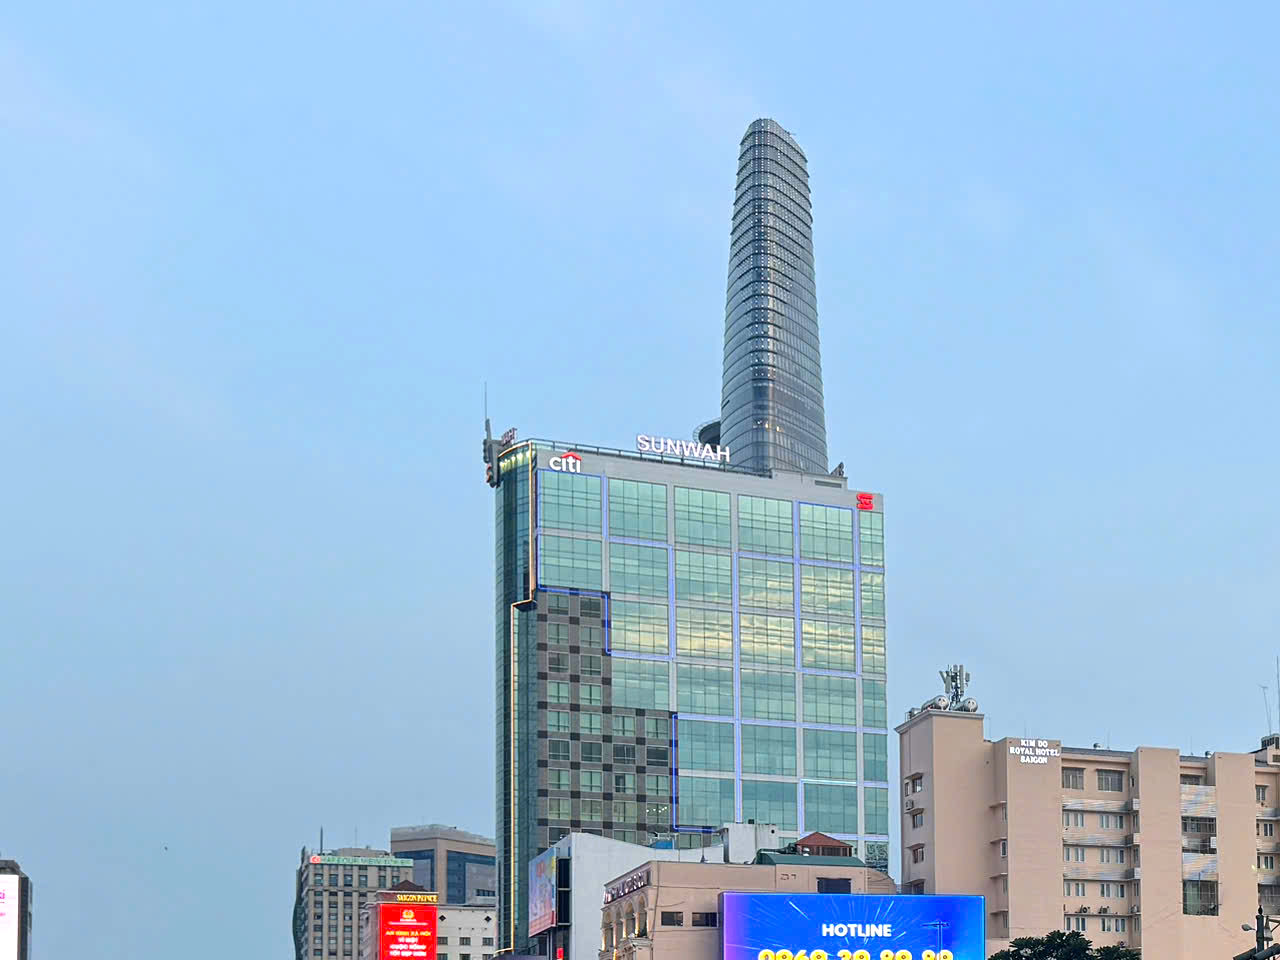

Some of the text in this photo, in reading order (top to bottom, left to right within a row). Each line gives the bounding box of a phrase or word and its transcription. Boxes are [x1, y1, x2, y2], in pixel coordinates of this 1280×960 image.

[637, 434, 731, 463] SUNWAH
[549, 454, 582, 473] citi
[1020, 739, 1048, 748] KIM DO
[1009, 747, 1060, 757] ROYAL HOTEL
[1020, 756, 1048, 764] SAIGON
[822, 923, 892, 937] HOTLINE
